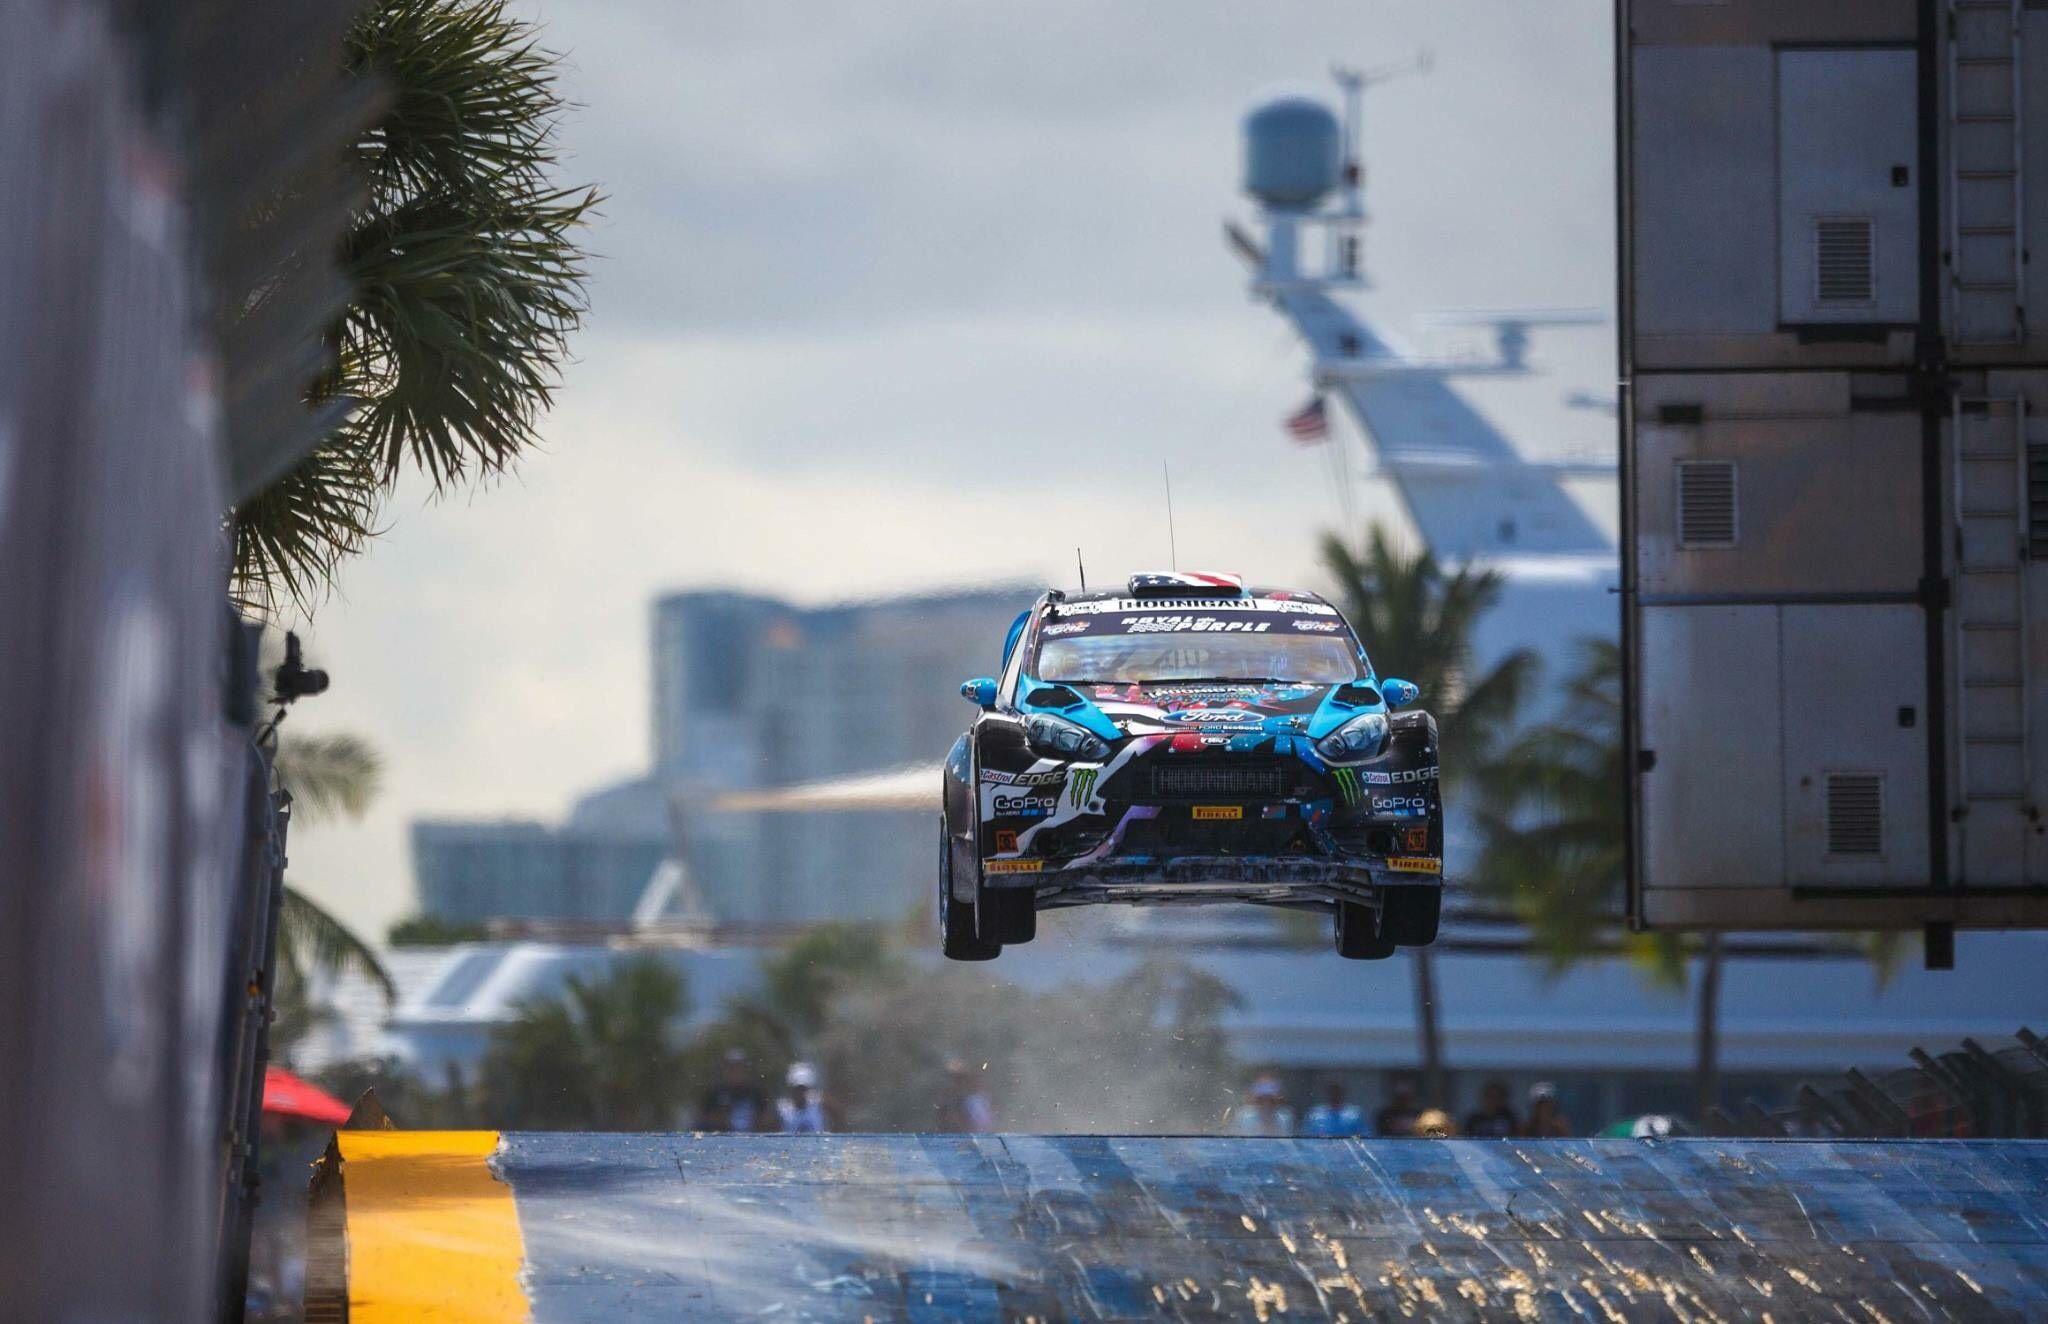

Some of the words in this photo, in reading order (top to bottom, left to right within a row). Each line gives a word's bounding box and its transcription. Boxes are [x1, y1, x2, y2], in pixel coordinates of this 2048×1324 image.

[1121, 616, 1194, 625] ROYAL
[1173, 621, 1271, 632] PURPLE
[1180, 710, 1245, 722] Ford
[982, 769, 1014, 783] Castrol
[1013, 771, 1065, 786] EDGE
[1391, 766, 1440, 784] EDGE
[995, 797, 1054, 809] GoPro
[1372, 797, 1425, 808] GoPro
[1196, 807, 1239, 819] PIRELLI
[1391, 858, 1437, 871] PIRELLI
